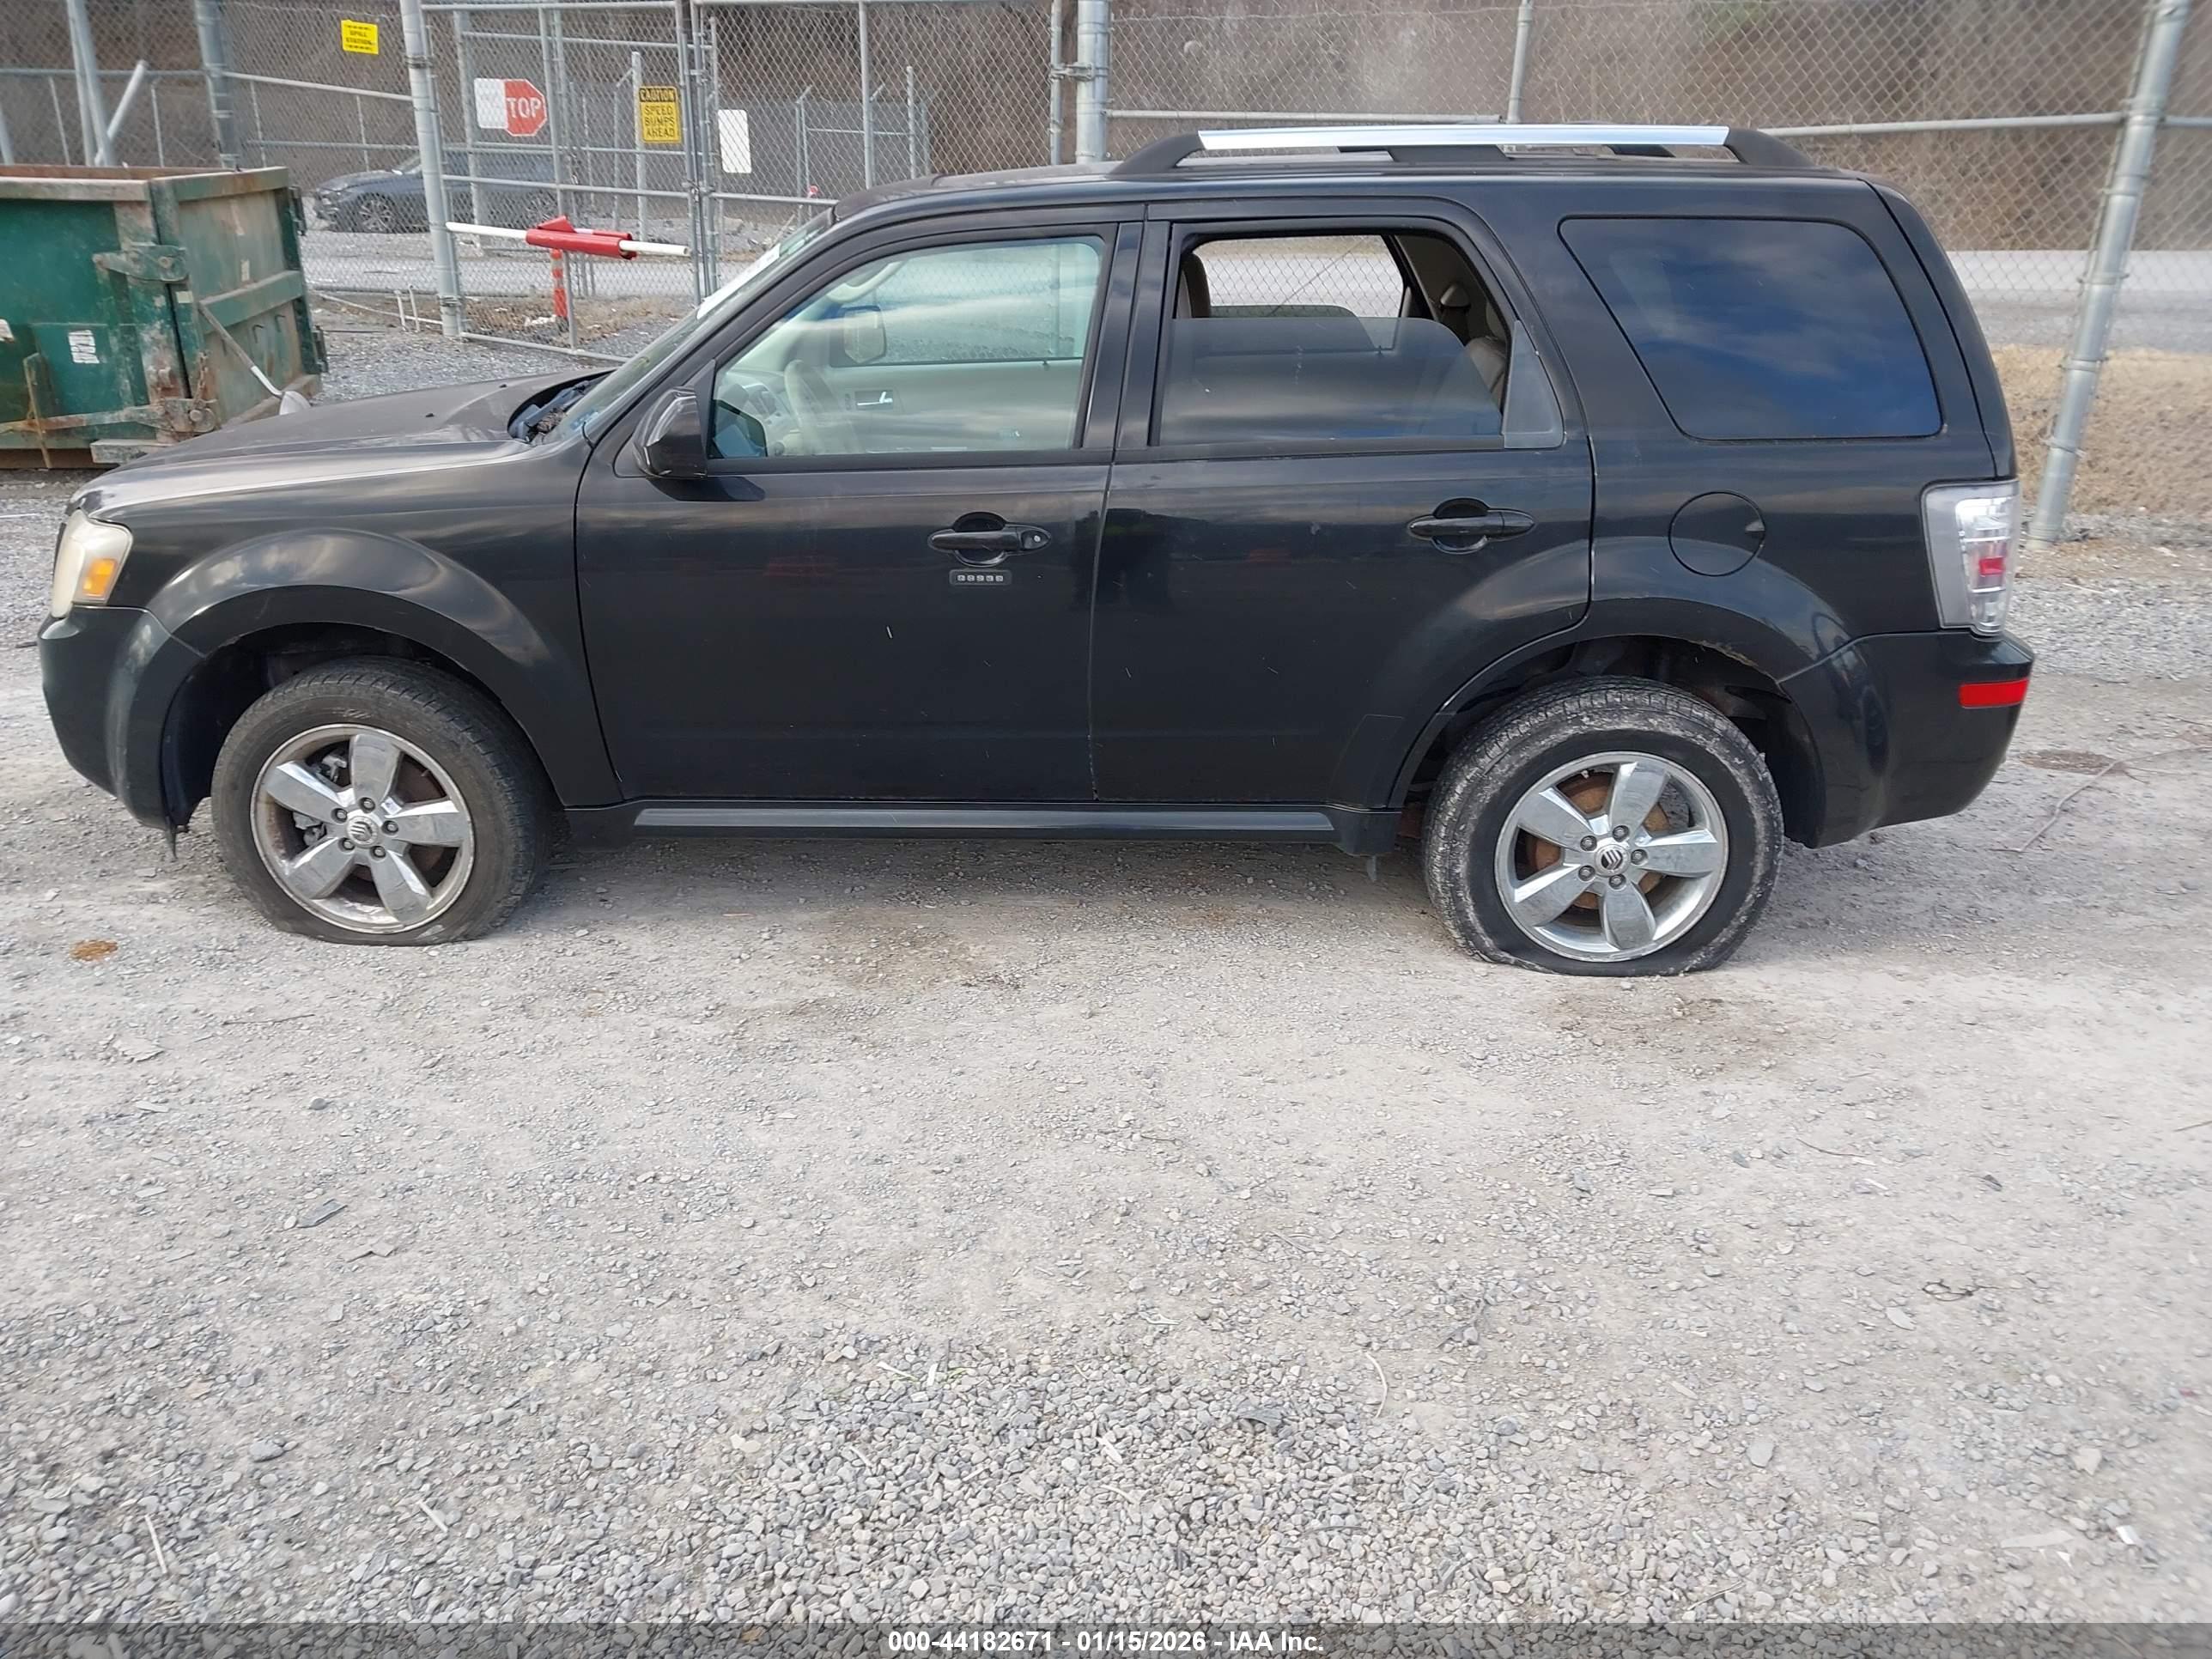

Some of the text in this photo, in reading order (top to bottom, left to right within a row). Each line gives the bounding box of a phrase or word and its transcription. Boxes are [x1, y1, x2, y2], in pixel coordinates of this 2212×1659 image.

[640, 88, 676, 102] CAUTION
[644, 105, 672, 116] SPEED
[645, 116, 675, 127] BUMPS
[646, 127, 675, 138] AHEAD
